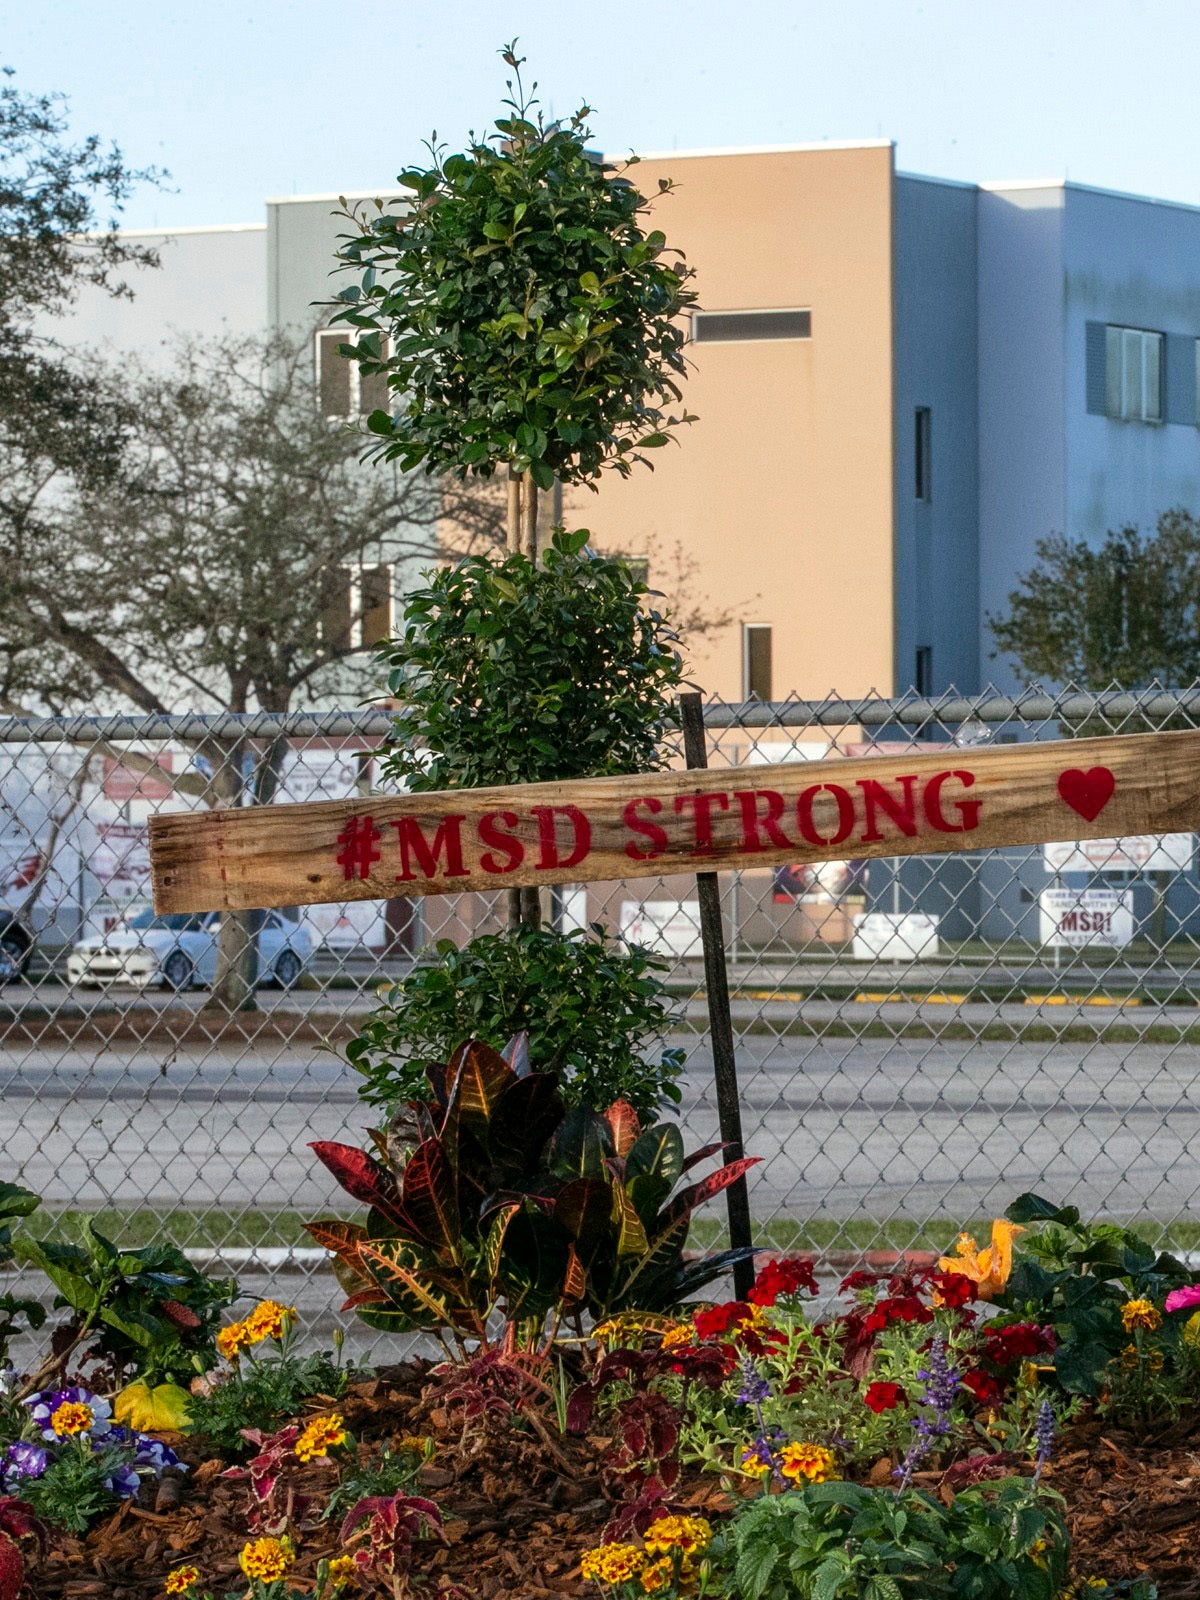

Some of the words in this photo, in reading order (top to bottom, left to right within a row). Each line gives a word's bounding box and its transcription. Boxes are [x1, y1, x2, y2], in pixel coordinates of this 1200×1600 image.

[336, 804, 592, 882] #MSD
[624, 770, 983, 861] STRONG
[1062, 911, 1111, 932] MSD!
